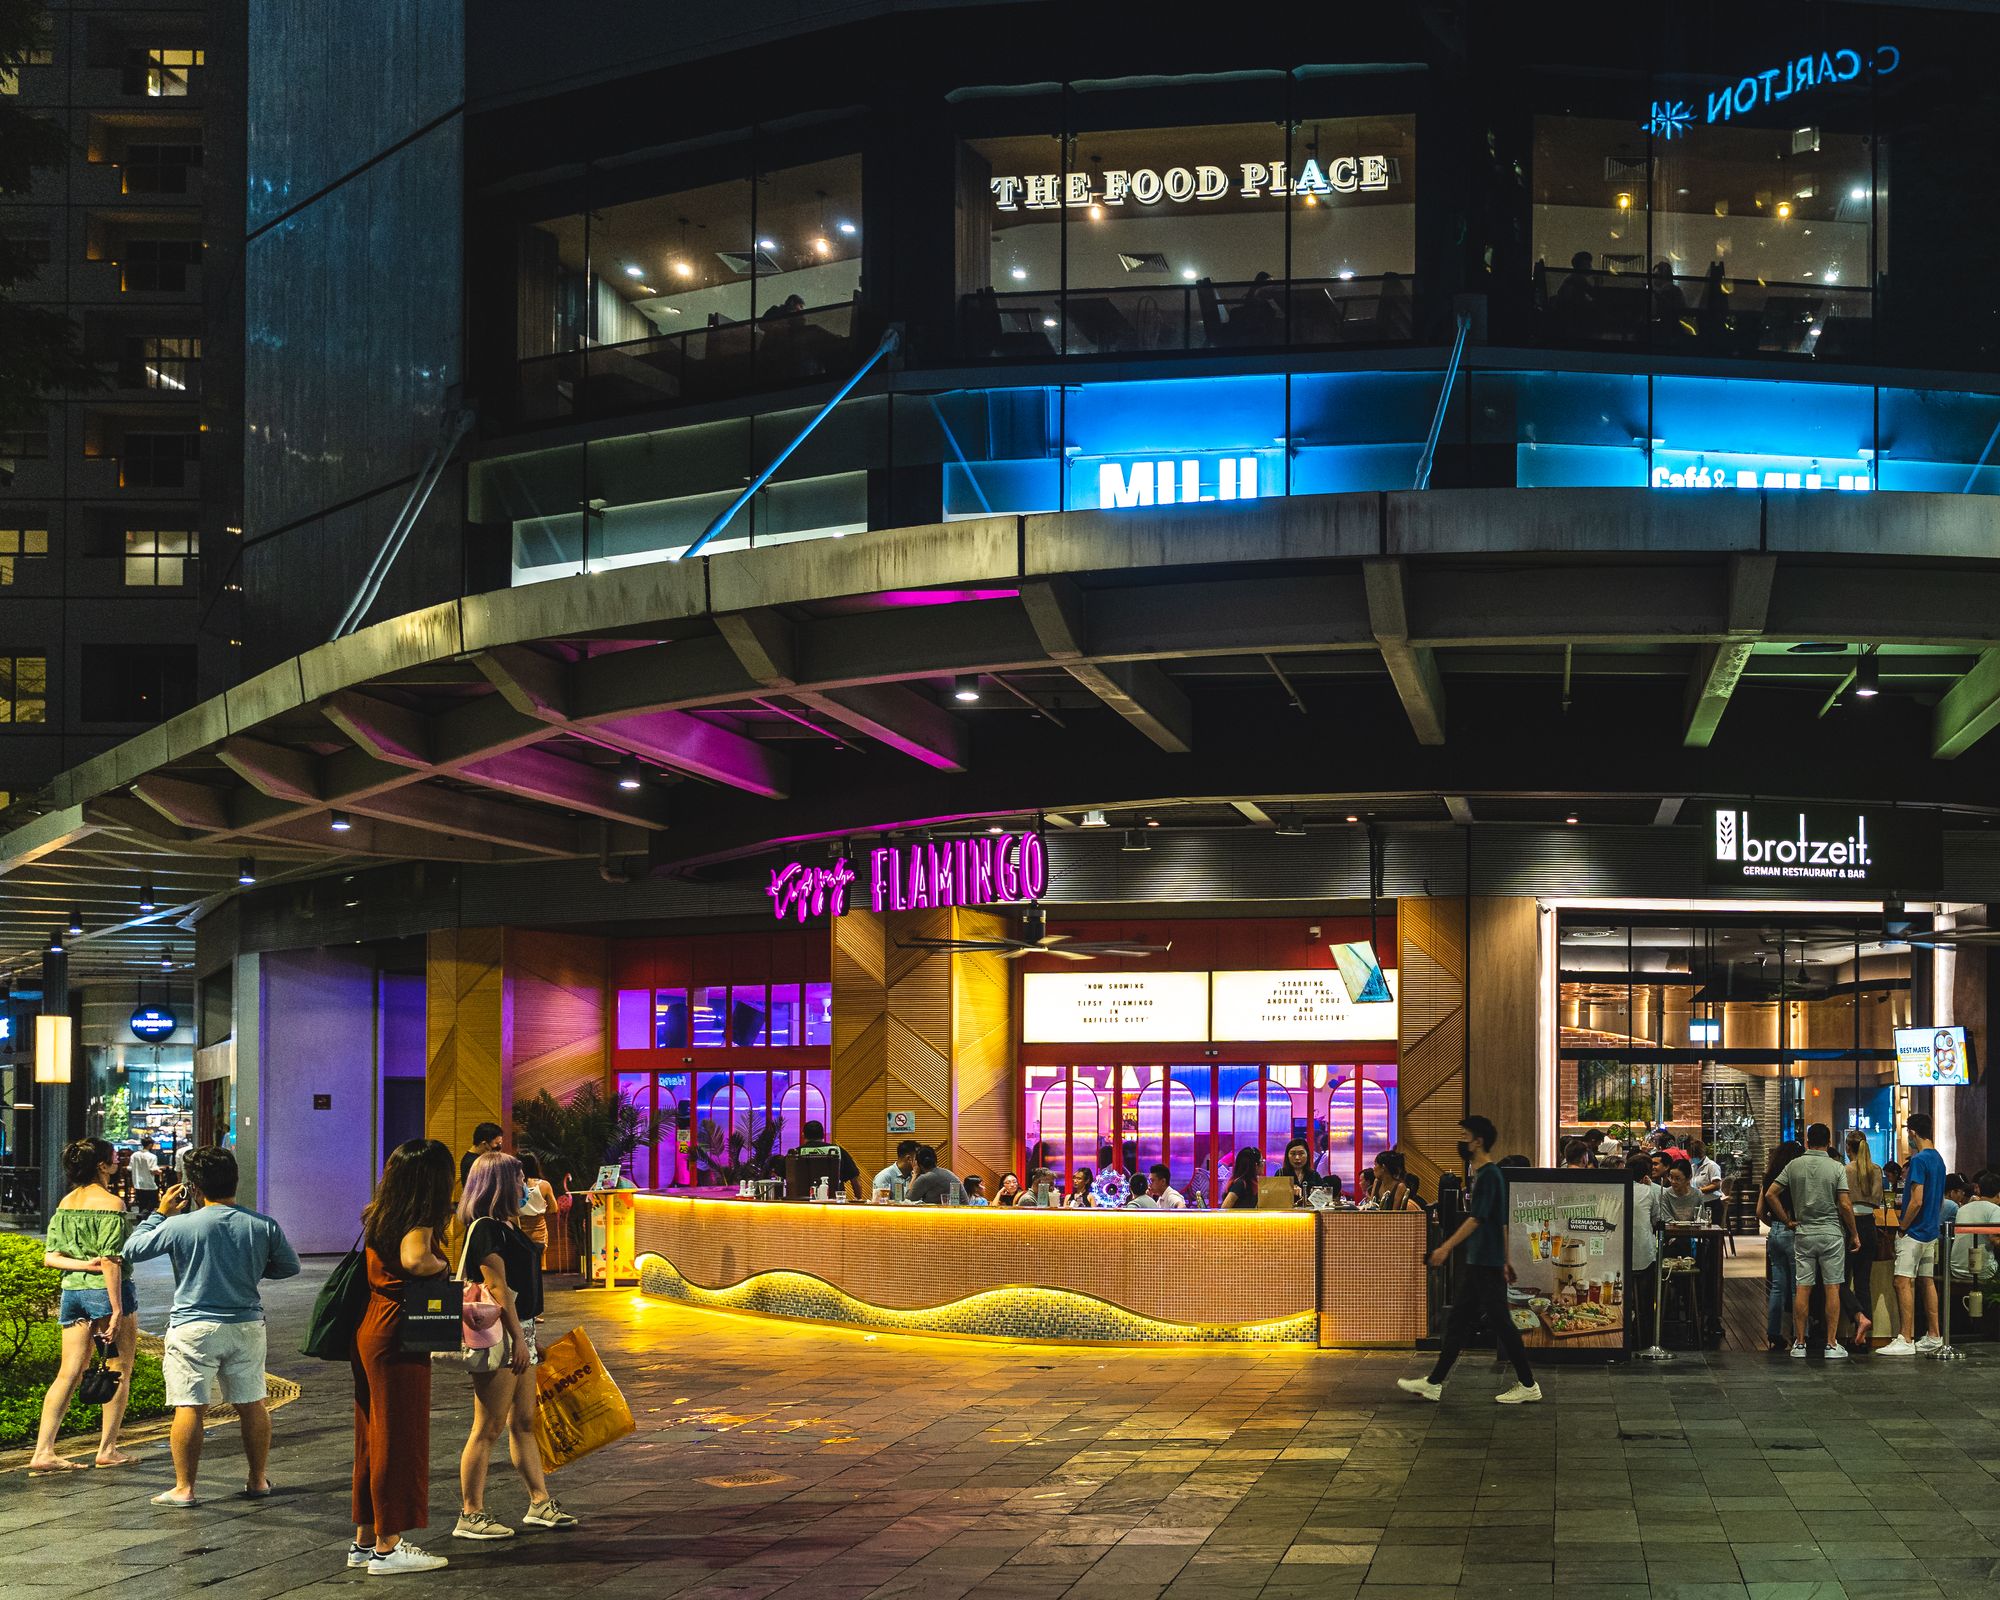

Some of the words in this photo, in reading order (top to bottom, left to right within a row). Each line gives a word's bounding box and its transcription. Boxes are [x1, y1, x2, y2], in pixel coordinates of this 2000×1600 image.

[990, 171, 1091, 211] THE
[1103, 164, 1229, 206] FOOD
[1240, 154, 1389, 199] PLACE
[871, 831, 1048, 913] FLAMINGO
[1742, 866, 1781, 876] GERMAN
[1782, 867, 1838, 878] RESTAURANT
[1839, 869, 1846, 878] &
[1847, 869, 1866, 879] BAR
[1517, 1191, 1555, 1208] brotzeit
[1513, 1206, 1558, 1224] SPARGEL
[1561, 1205, 1597, 1220] WOCHEN
